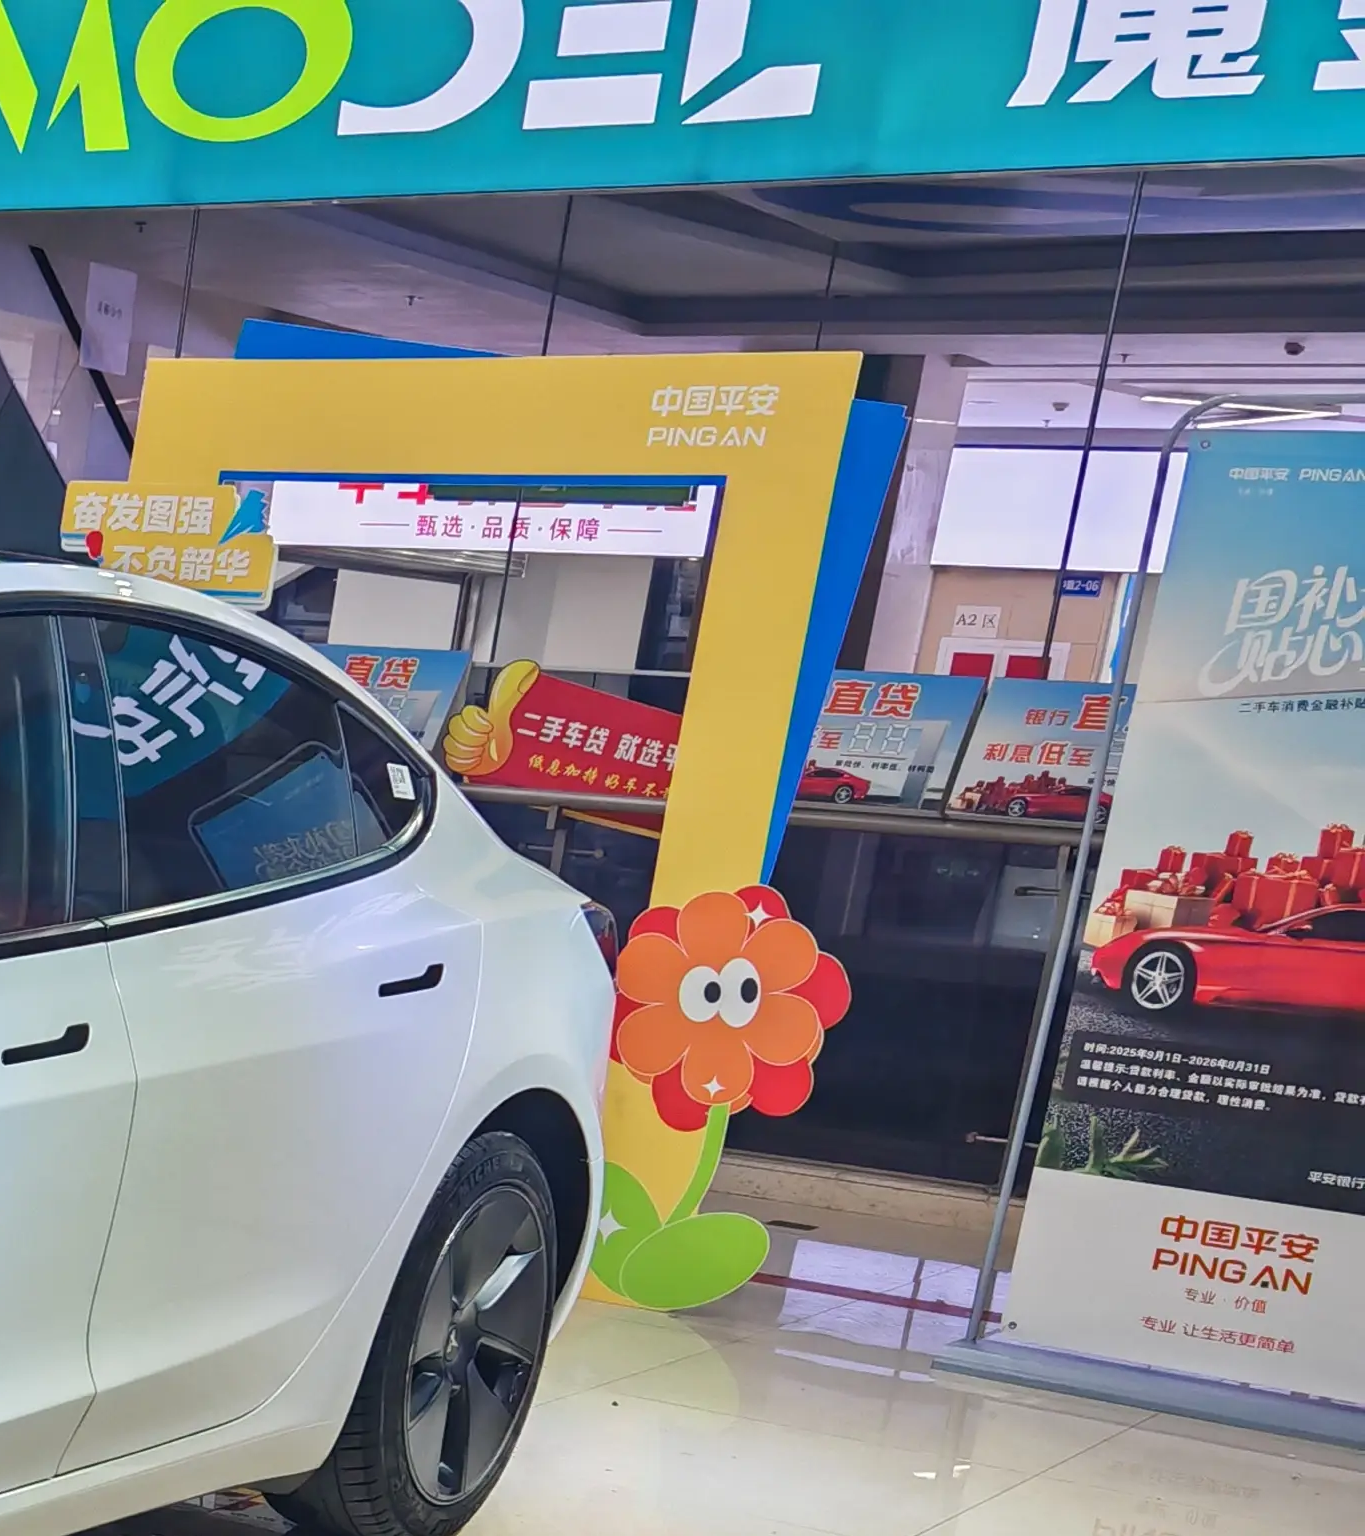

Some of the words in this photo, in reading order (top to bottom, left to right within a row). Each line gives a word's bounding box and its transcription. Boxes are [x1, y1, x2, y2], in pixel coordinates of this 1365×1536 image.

[650, 384, 780, 418] 中国平安
[1228, 467, 1291, 483] 中国平安
[72, 492, 216, 536] 奋发图强
[110, 543, 251, 583] 不负韶华
[955, 613, 978, 627] A2
[981, 613, 997, 629] 区
[345, 653, 420, 691] 直贷
[822, 678, 923, 722] 直贷
[1024, 707, 1071, 728] 银行
[516, 711, 611, 757] 二手车贷
[982, 740, 1097, 768] 利息低至
[1159, 1213, 1321, 1264] 中国平安
[1151, 1247, 1313, 1296] PINGAN
[1139, 1314, 1178, 1336] 专业
[1181, 1321, 1296, 1355] 让生活更简单
